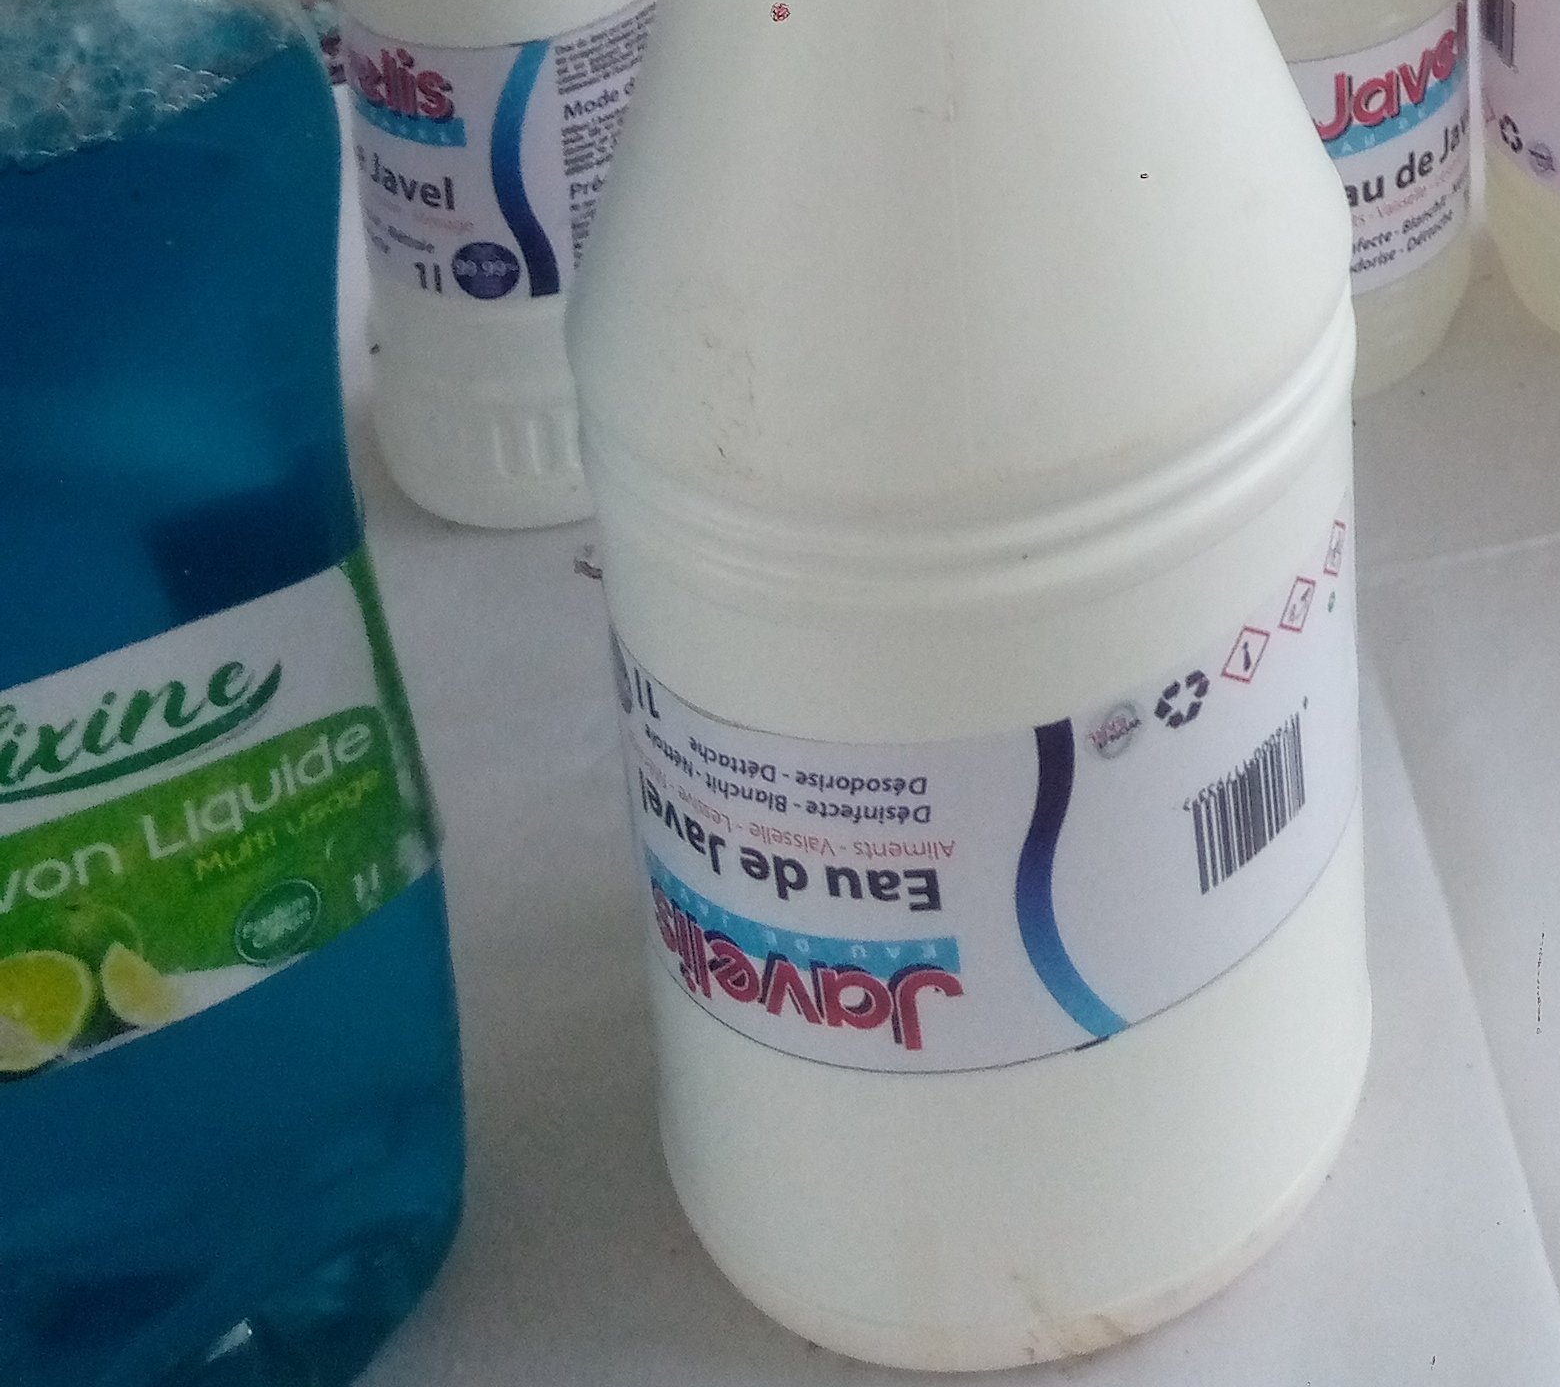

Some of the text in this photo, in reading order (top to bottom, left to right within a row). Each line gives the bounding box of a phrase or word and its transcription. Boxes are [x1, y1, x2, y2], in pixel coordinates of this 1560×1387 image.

[348, 47, 456, 122] elis
[370, 152, 456, 211] Javel
[1344, 174, 1384, 207] au
[1396, 149, 1434, 189] de
[0, 661, 255, 786] ixine
[688, 735, 777, 784] Déttache
[795, 769, 928, 796] Désodorise
[141, 722, 373, 860] Liquide
[705, 772, 788, 814] Blanchit
[805, 799, 932, 825] Désinfecte
[638, 766, 943, 912] Eau de Javel
[750, 821, 837, 858] Vaisselle
[853, 838, 956, 861] Aliments
[651, 877, 965, 1051] Javelis
